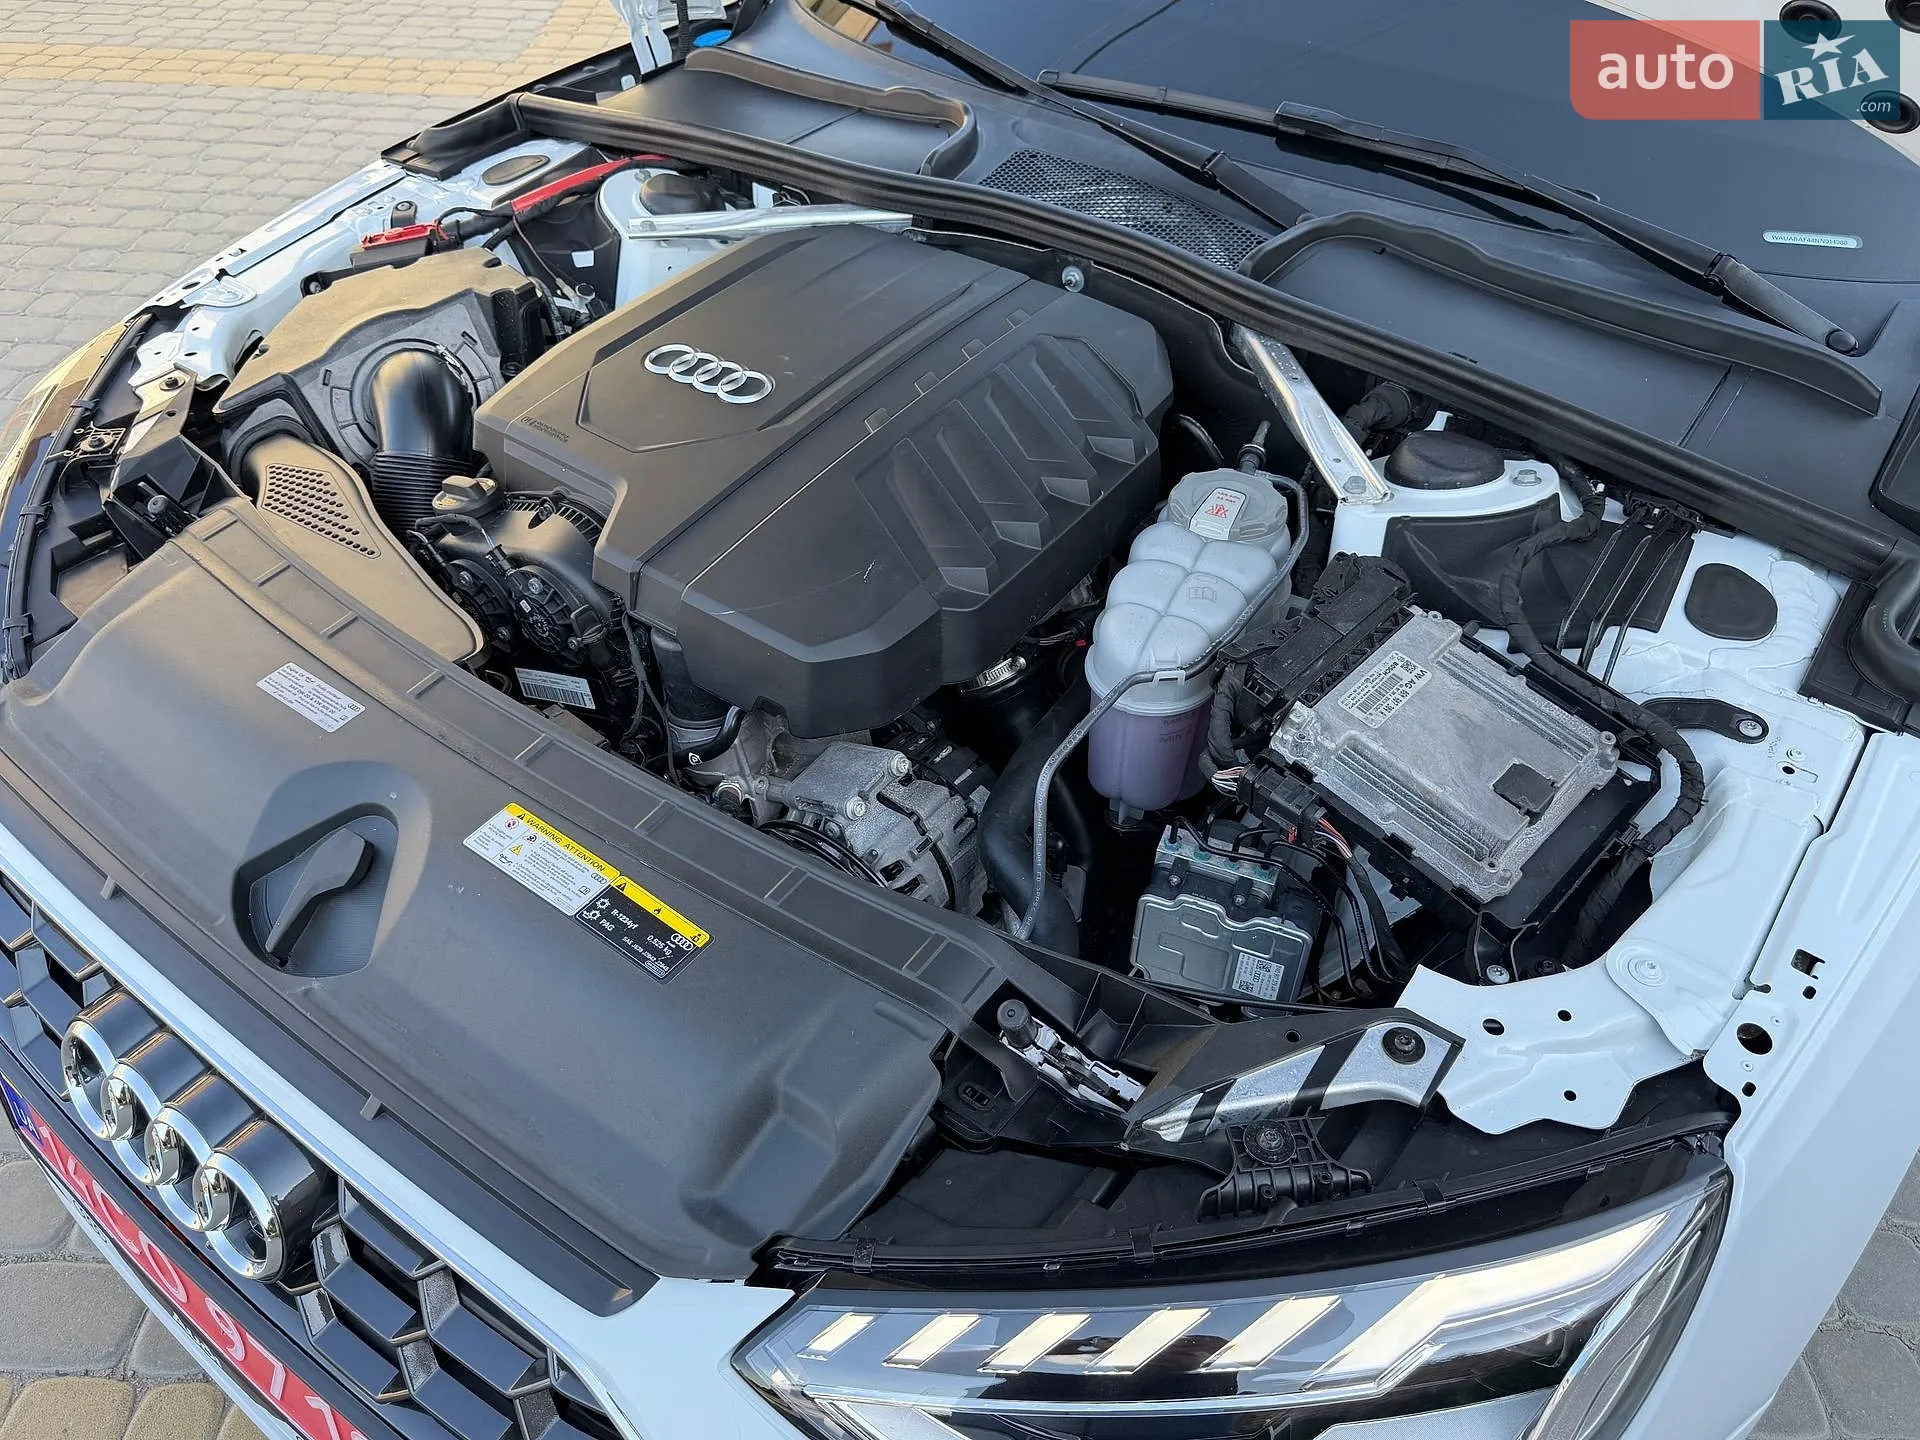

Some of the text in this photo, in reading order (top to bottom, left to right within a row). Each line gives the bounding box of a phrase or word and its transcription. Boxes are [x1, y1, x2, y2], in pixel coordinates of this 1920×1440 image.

[1404, 669, 1428, 690] VW AG
[526, 817, 563, 845] WARNING
[563, 843, 607, 873] ATTENTION
[599, 918, 615, 932] PAG
[611, 908, 639, 930] R-1234yf
[663, 945, 673, 956] kg
